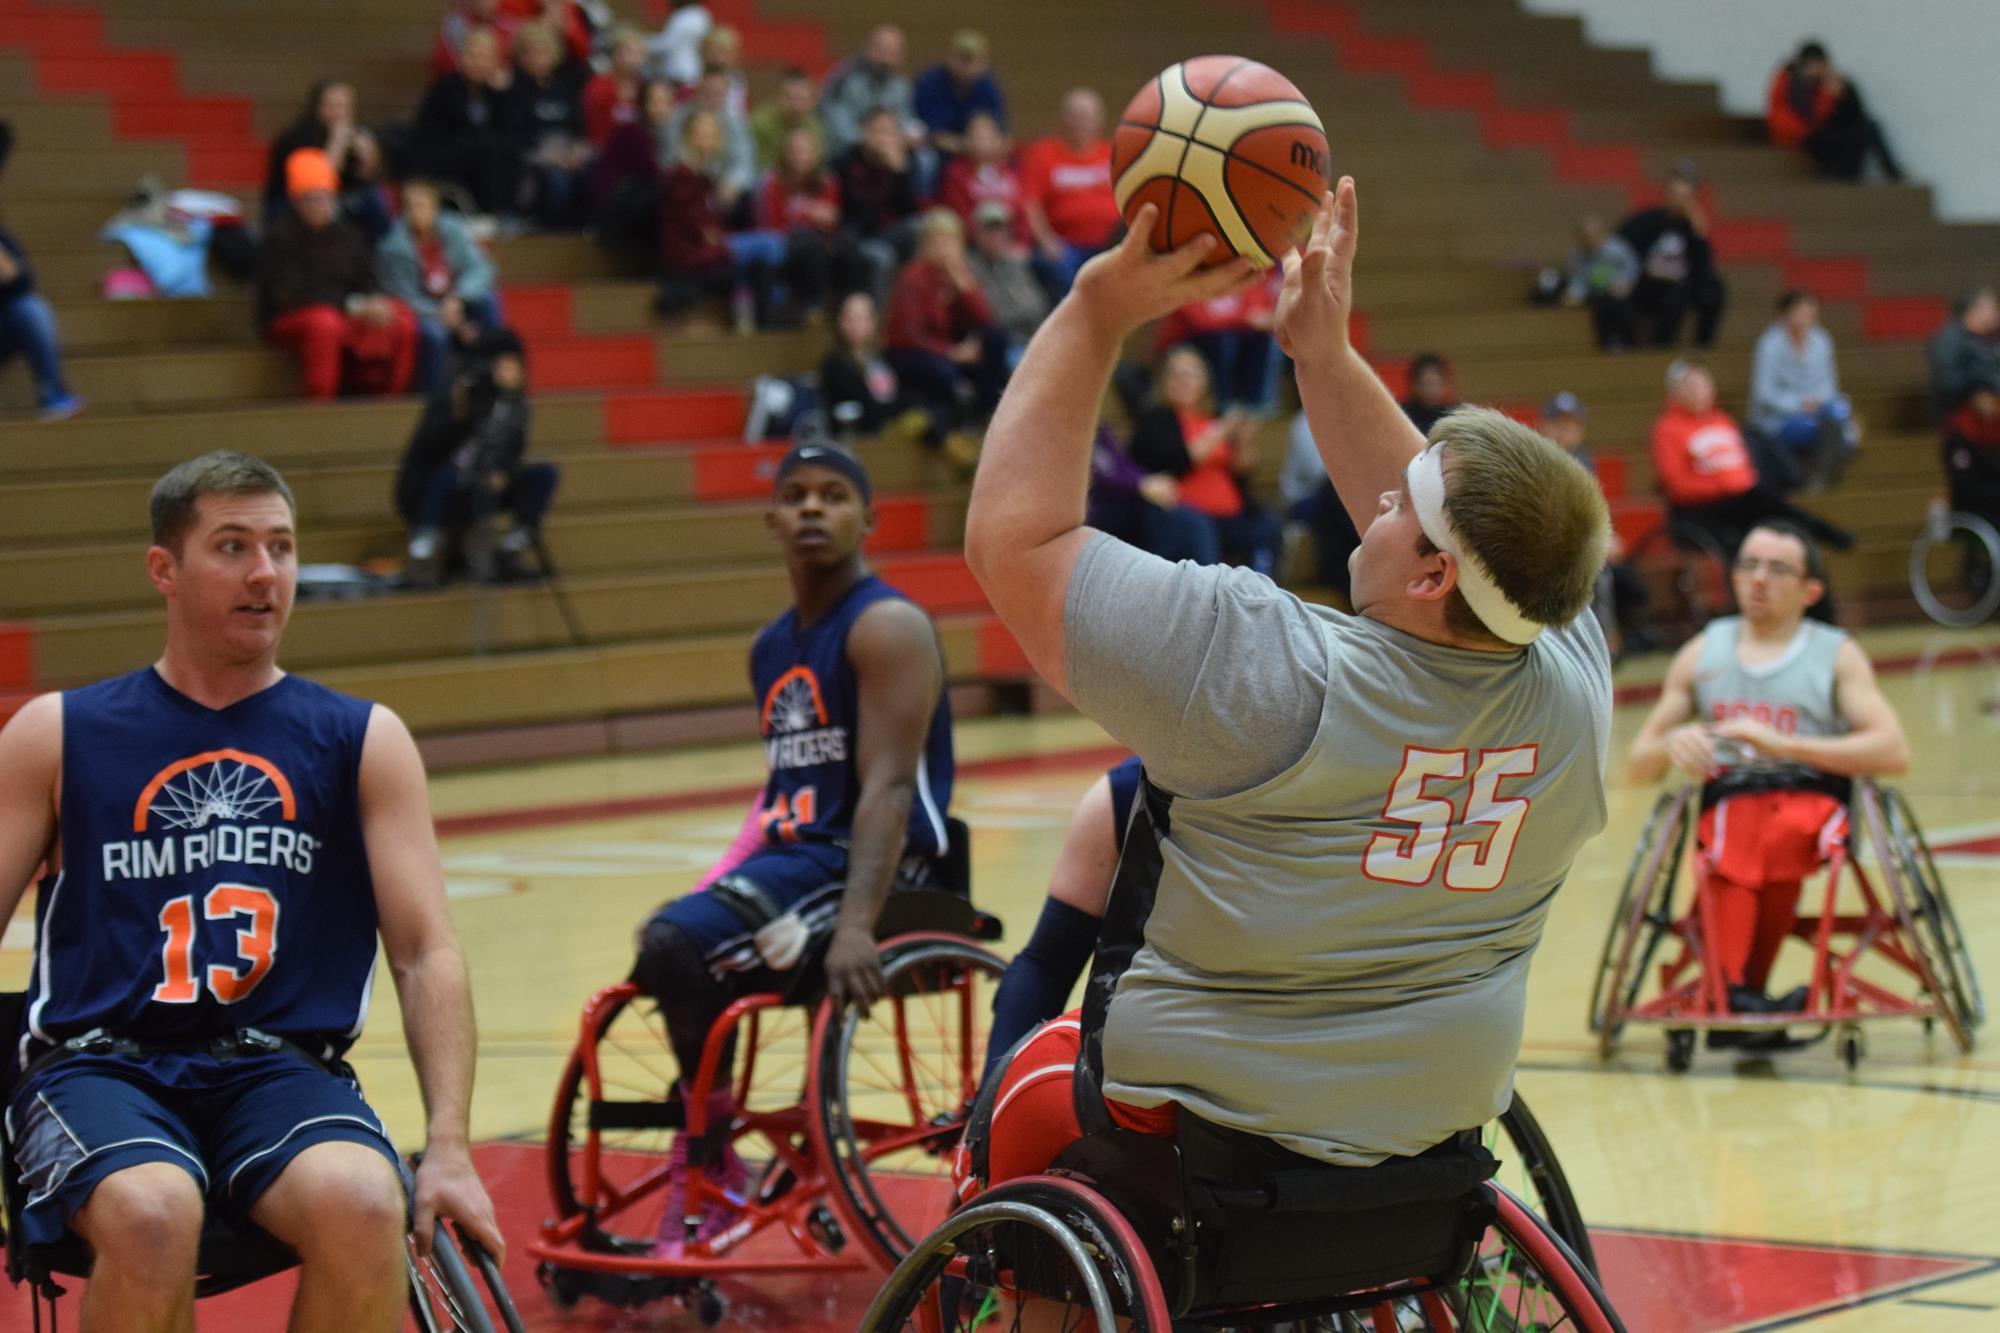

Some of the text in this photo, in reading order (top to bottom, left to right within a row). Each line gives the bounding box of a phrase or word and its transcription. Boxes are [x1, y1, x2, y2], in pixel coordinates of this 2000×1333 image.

[103, 825, 314, 881] RIM RIDERS
[1361, 744, 1539, 892] 55
[151, 882, 280, 1005] 13
